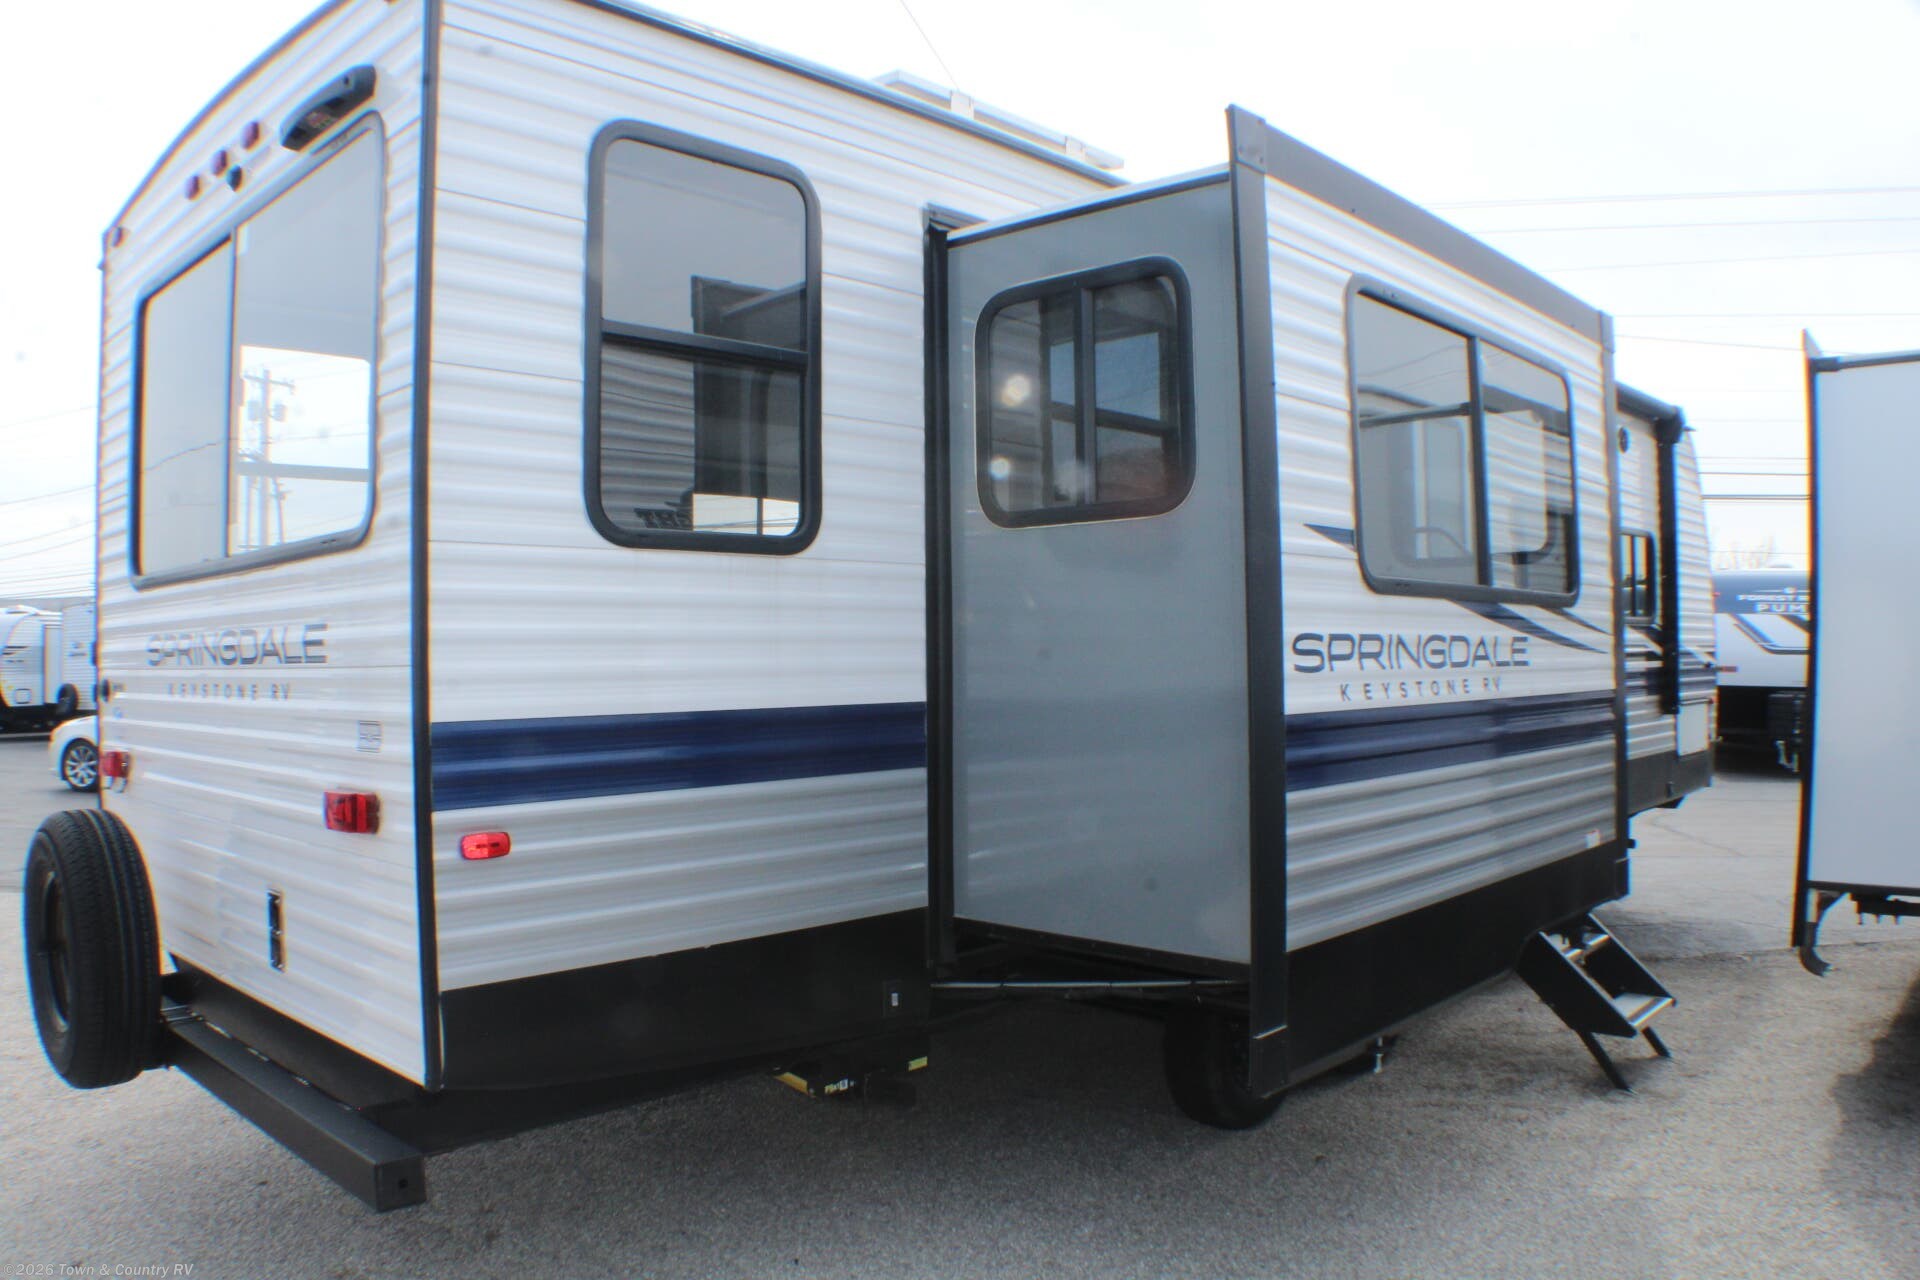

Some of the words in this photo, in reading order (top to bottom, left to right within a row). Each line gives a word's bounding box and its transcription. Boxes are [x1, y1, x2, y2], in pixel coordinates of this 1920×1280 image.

[1754, 602, 1809, 613] PUM
[147, 624, 328, 666] SPRINGDALE
[1292, 632, 1529, 673] SPRINGDALE
[168, 682, 258, 700] KEYSTONE
[271, 682, 291, 701] RV
[1340, 678, 1471, 702] KEYSTONE
[1482, 677, 1501, 694] RV
